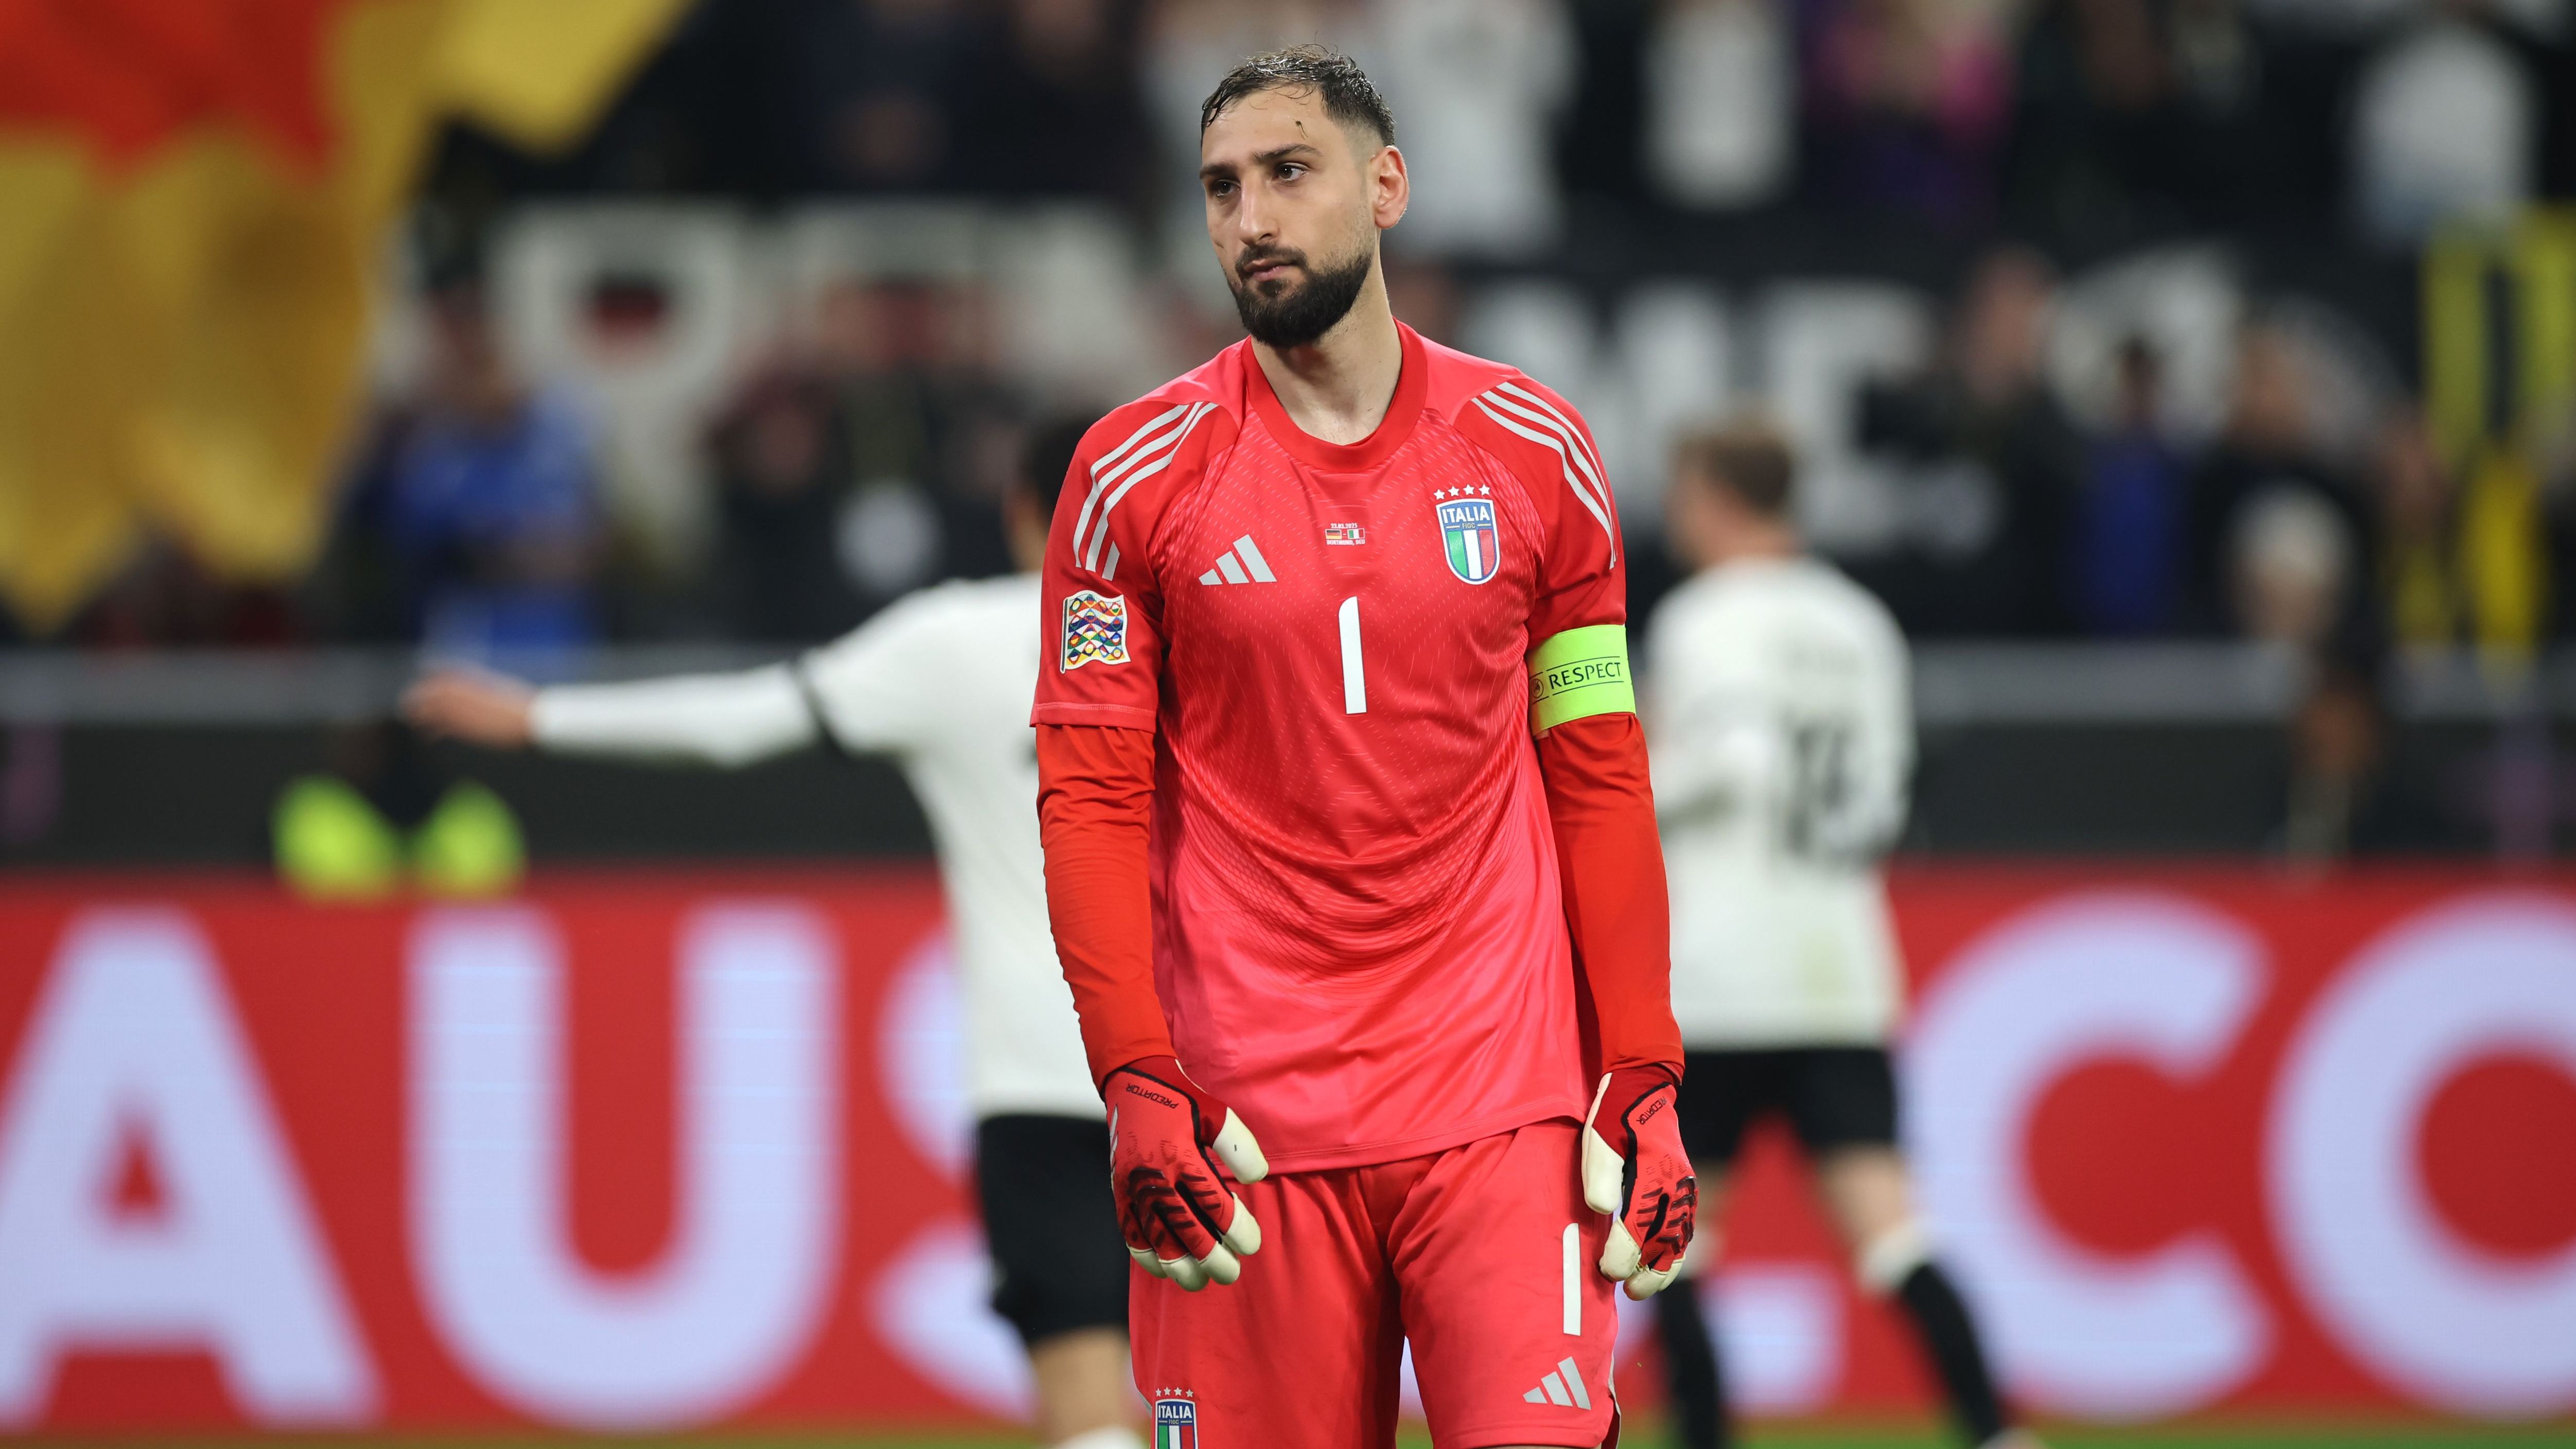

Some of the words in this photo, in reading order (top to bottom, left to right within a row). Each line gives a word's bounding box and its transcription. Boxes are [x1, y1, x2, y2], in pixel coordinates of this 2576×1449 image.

[1442, 505, 1490, 523] ITALIA
[1338, 596, 1367, 714] 1
[1548, 662, 1621, 690] RESPECT
[1126, 1083, 1179, 1109] PREDATOR
[1563, 1222, 1581, 1336] 1
[1158, 1405, 1193, 1419] ITALIA
